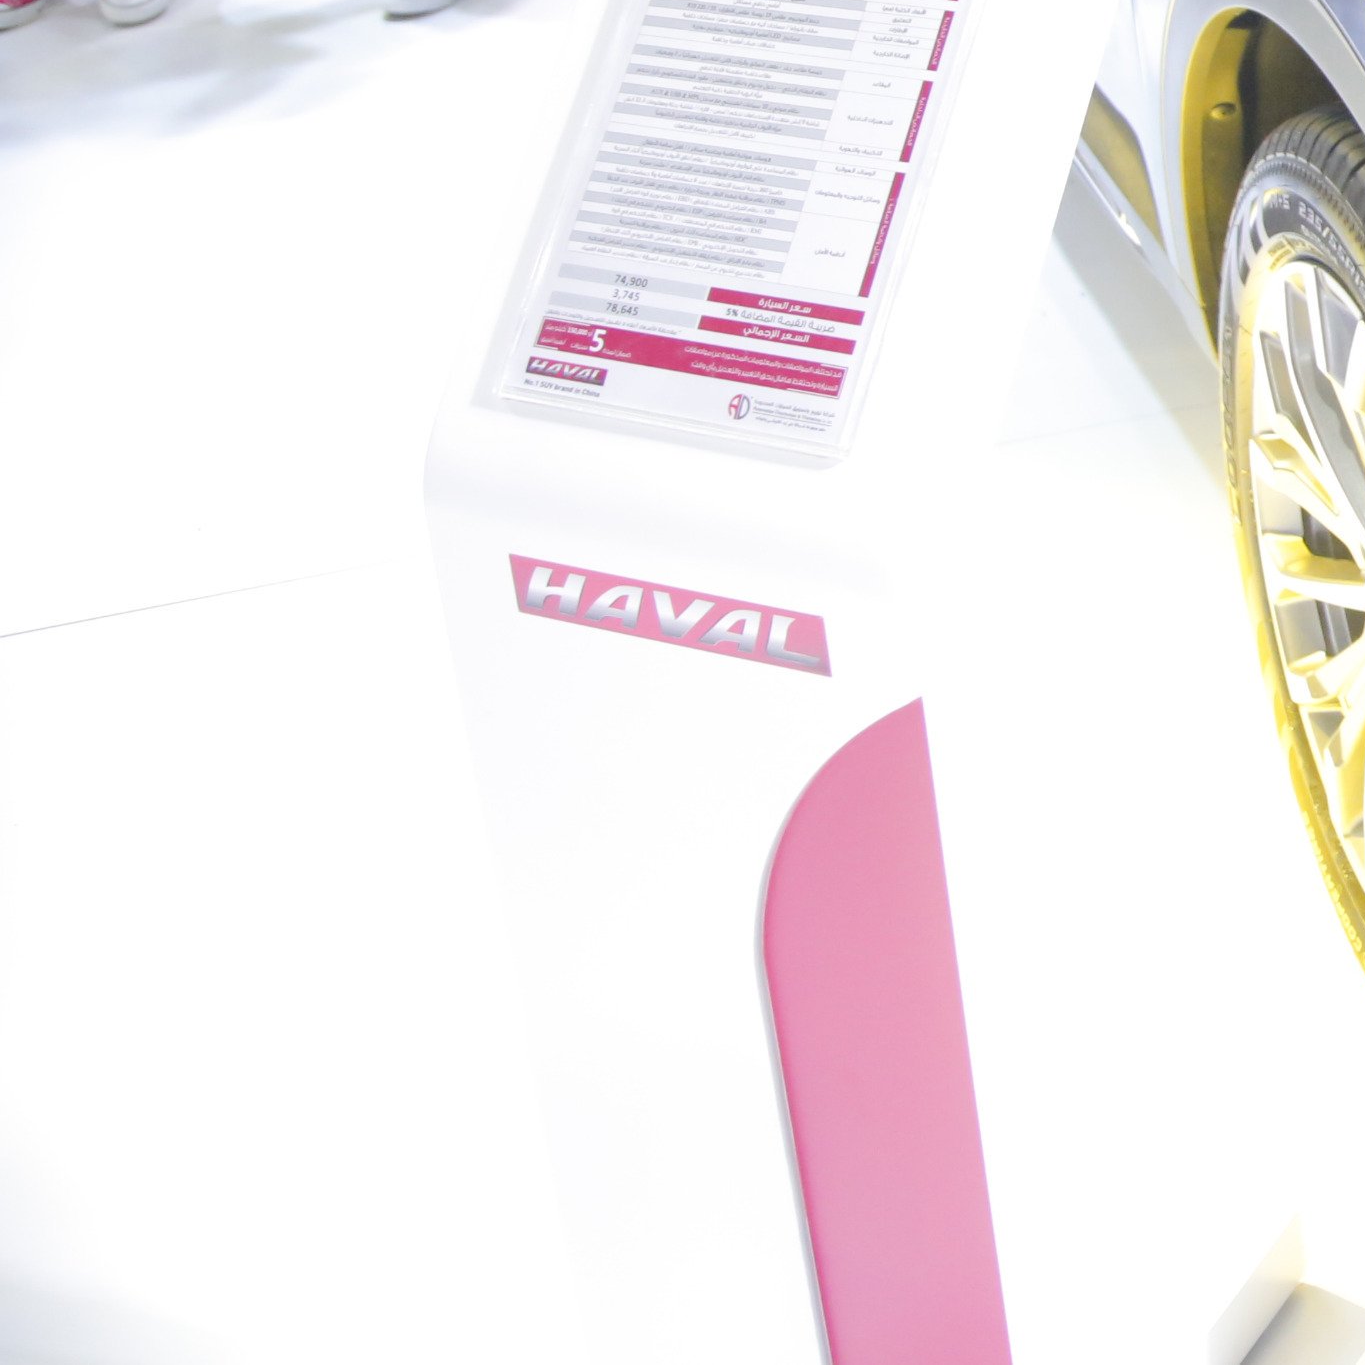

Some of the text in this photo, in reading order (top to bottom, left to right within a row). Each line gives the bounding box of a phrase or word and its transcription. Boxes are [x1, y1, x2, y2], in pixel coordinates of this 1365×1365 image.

[614, 273, 648, 287] 74,900
[612, 288, 640, 301] 3,745
[606, 301, 638, 316] 78,645
[758, 298, 811, 313] سعر السيارة
[739, 309, 776, 323] المضافة
[777, 315, 807, 328] القيمة
[742, 325, 810, 342] السعر الإجمالي
[807, 320, 835, 333] ضريبة
[588, 328, 606, 352] 5
[525, 566, 821, 667] HAVAL
